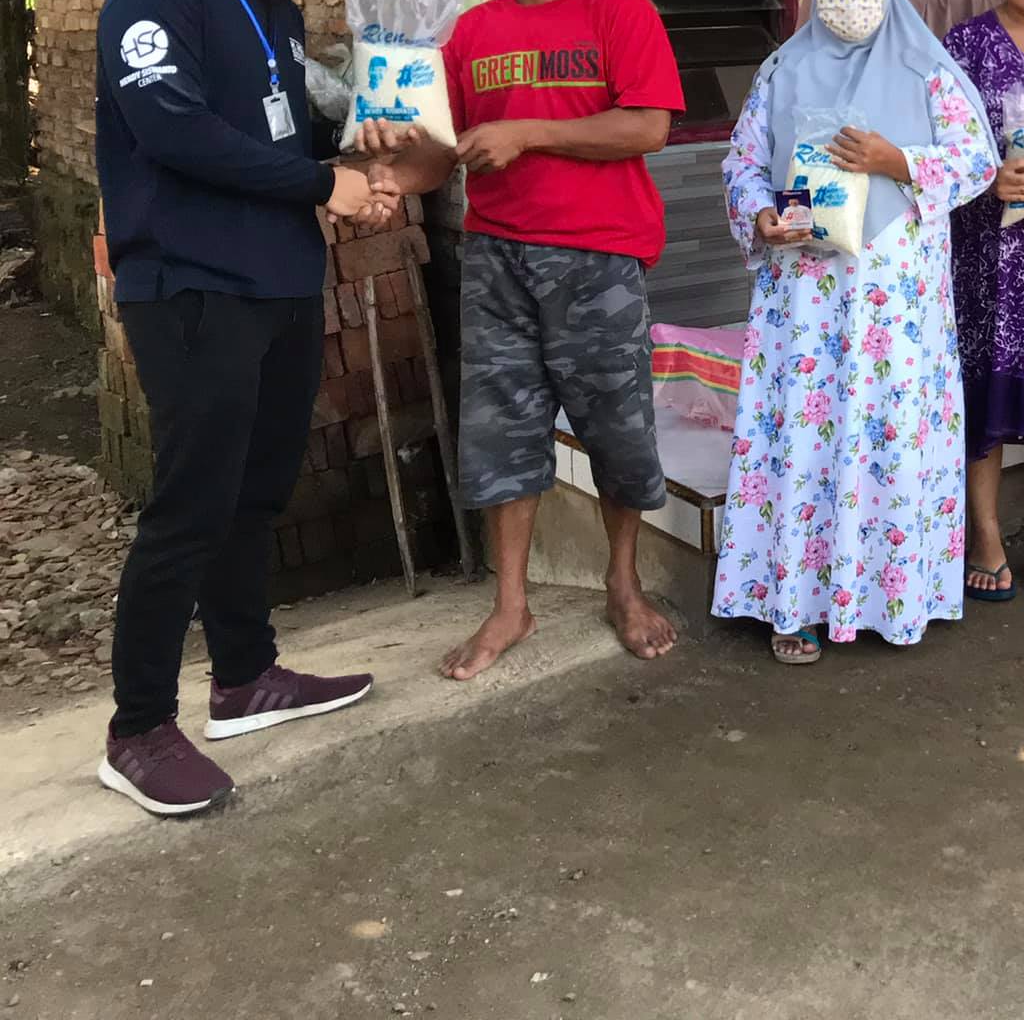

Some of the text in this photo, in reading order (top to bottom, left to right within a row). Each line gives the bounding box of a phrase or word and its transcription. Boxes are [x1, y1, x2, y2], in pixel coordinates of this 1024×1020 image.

[121, 27, 168, 63] HSC
[475, 52, 536, 90] GREEN
[540, 49, 599, 80] MOSS
